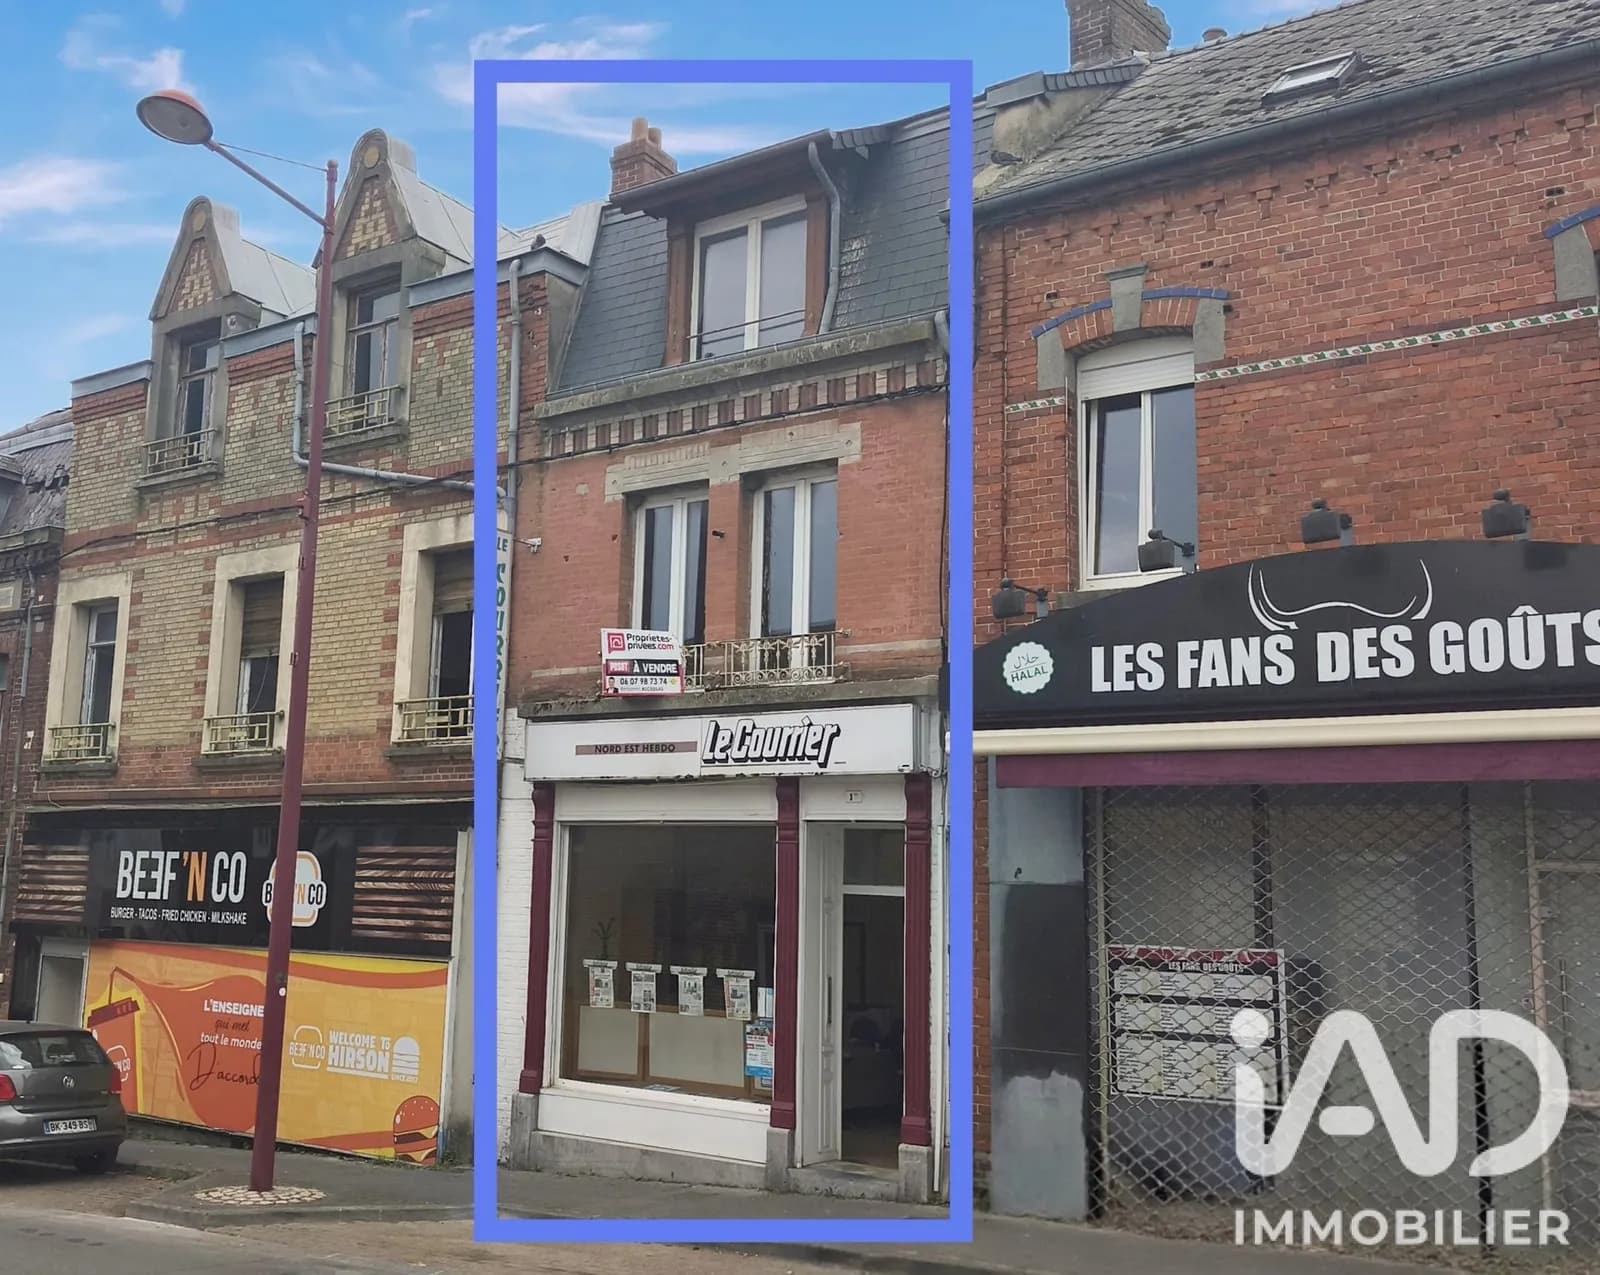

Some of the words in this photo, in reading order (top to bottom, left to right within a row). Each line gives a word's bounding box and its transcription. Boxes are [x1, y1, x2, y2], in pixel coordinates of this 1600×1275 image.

[1091, 641, 1164, 692] LES
[1176, 633, 1295, 689] FANS
[1316, 624, 1415, 682] DES
[642, 663, 678, 673] VENDRE
[1010, 665, 1049, 683] HALAL
[594, 743, 622, 754] NORD
[624, 743, 640, 753] EST
[642, 743, 676, 753] HEBDO
[211, 851, 247, 903] CO
[308, 883, 324, 905] CO
[110, 906, 135, 919] BURGER
[138, 908, 158, 920] TACOS
[161, 909, 179, 921] FRIED
[180, 910, 207, 923] CHICKEN
[211, 911, 248, 925] MILKSHAKE
[203, 999, 264, 1017] L'ENSEIGNE
[200, 1032, 219, 1044] tout
[221, 1034, 229, 1046] le
[230, 1037, 262, 1050] monde
[329, 1030, 376, 1048] WELCOME
[328, 1045, 390, 1072] HIRSON
